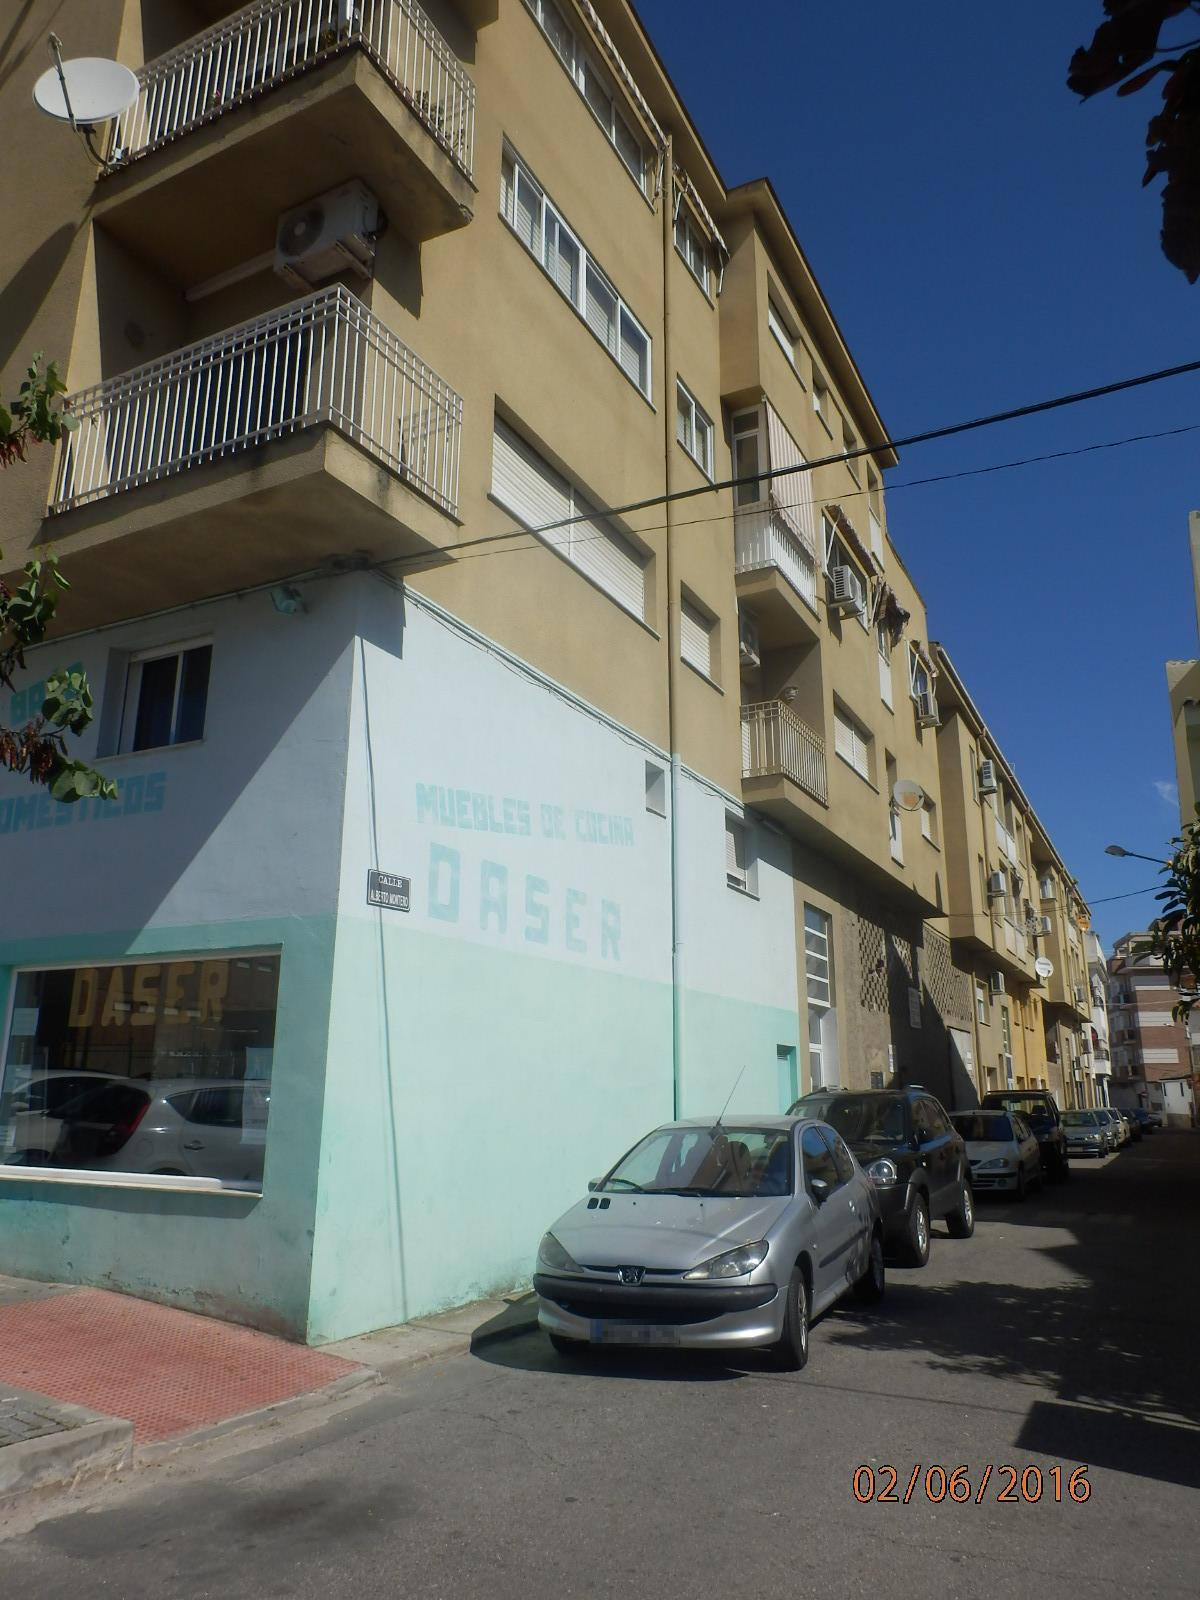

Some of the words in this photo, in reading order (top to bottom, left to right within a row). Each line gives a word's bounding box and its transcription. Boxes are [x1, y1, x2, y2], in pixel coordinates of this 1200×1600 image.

[415, 782, 531, 836] MUEBLES
[540, 803, 566, 840] DE
[575, 809, 635, 847] COCINA
[378, 875, 403, 888] CALLE
[427, 841, 622, 961] DASER
[68, 959, 230, 1027] DASER
